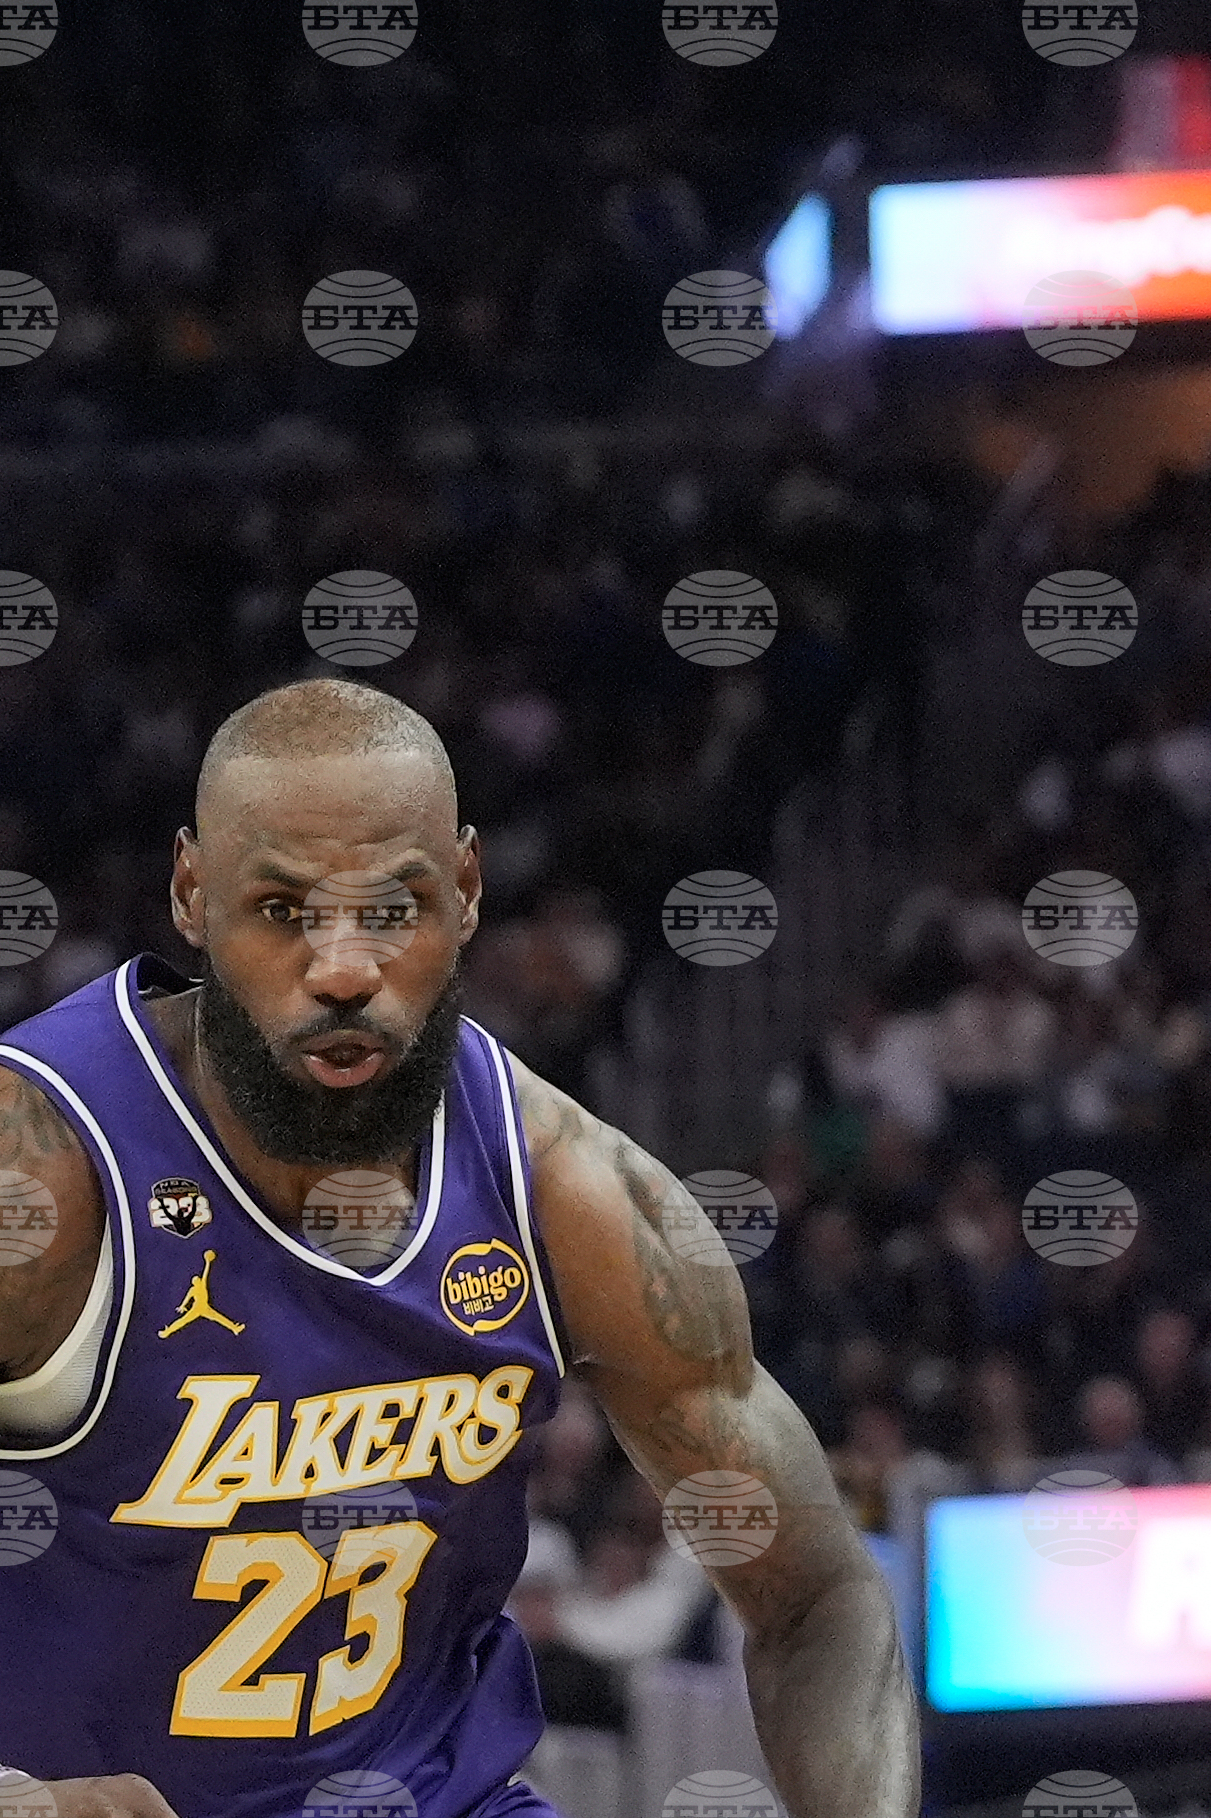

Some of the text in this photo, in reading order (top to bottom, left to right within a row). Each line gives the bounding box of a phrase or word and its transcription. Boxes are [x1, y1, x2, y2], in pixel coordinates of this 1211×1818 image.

[446, 1265, 521, 1304] bibigo
[462, 1296, 494, 1315] 비비고
[109, 1365, 534, 1528] LAKERS
[169, 1521, 438, 1738] 23
